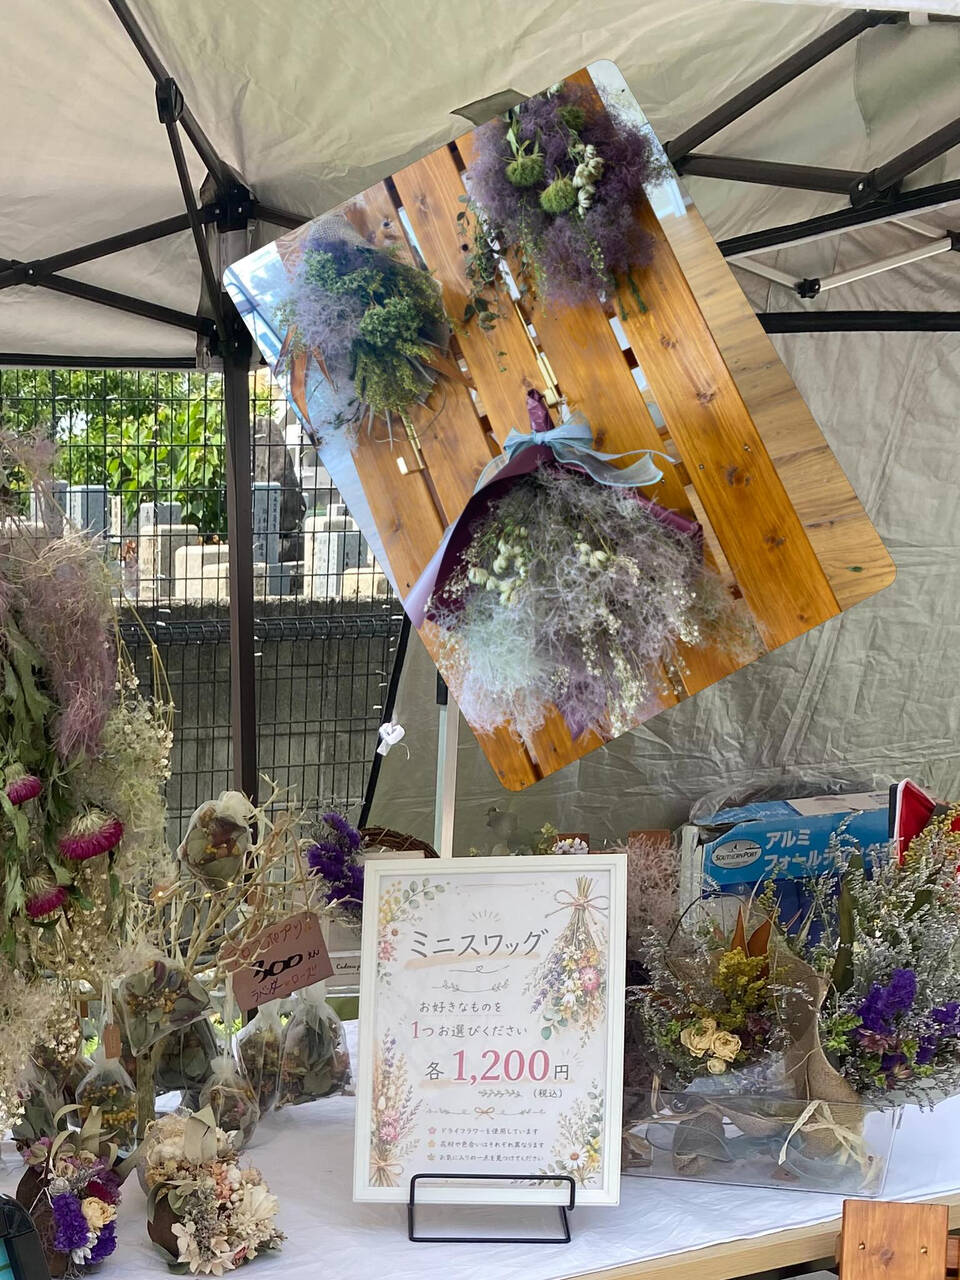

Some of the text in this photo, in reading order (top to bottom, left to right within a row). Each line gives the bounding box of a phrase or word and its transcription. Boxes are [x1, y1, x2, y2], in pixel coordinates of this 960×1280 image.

[766, 829, 810, 850] アルミ
[411, 929, 549, 958] ミニスワッグ
[419, 1002, 504, 1014] お好きなものを
[411, 1021, 528, 1039] 1つお選びください
